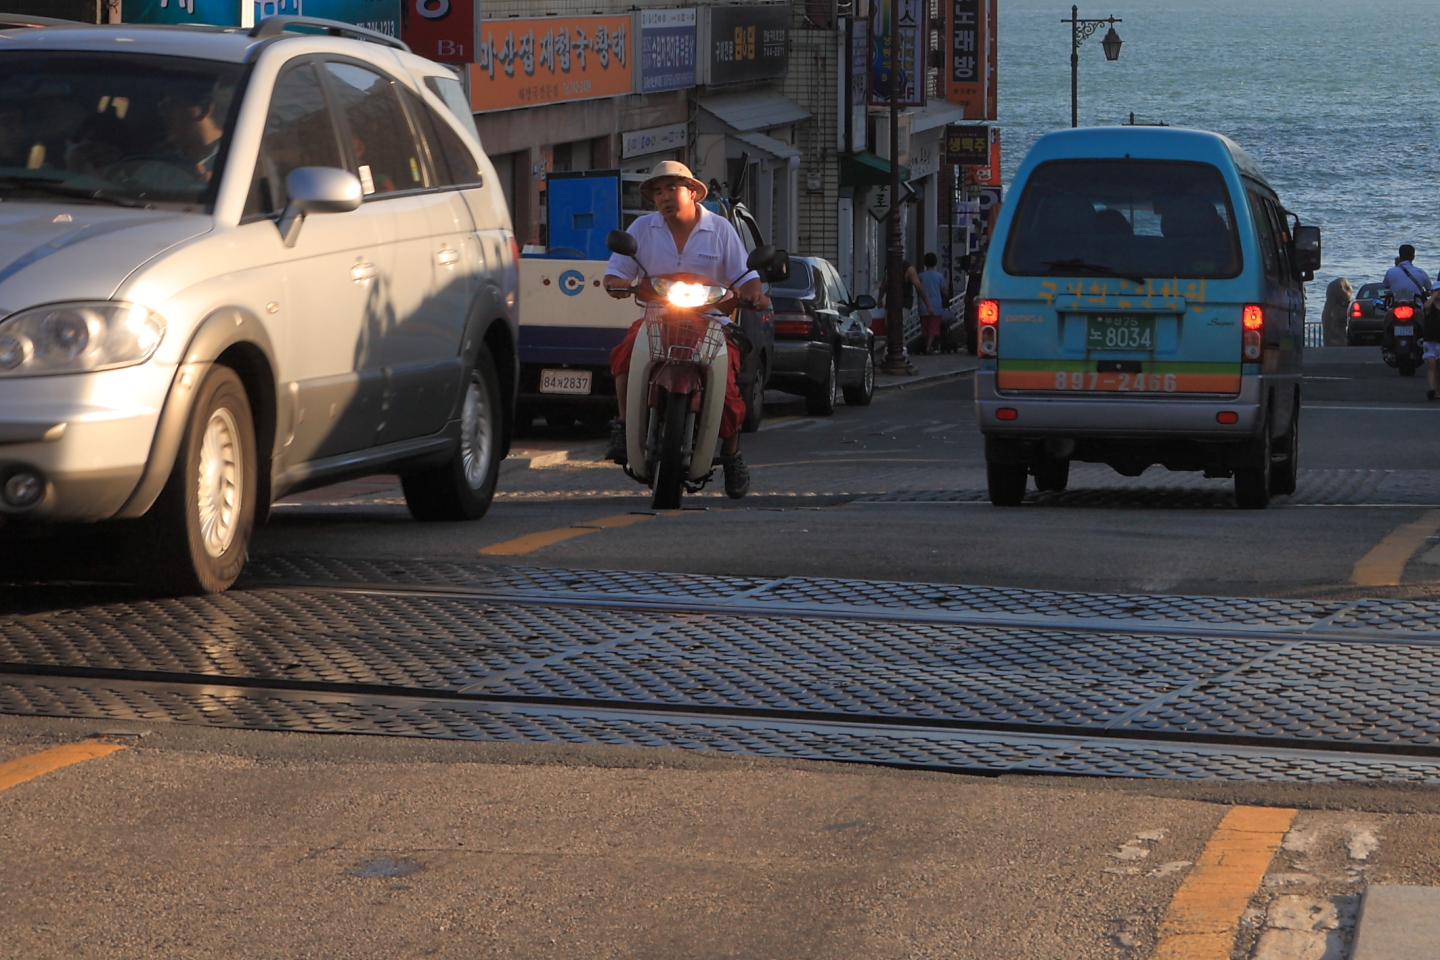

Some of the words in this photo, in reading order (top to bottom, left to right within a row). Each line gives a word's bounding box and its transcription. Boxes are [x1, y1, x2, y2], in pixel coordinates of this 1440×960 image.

[437, 40, 465, 56] B1
[954, 4, 975, 78] 노래방
[481, 29, 534, 80] 마산집
[948, 137, 986, 152] 생맥주
[1106, 327, 1151, 347] 8034
[1054, 371, 1177, 392] 897-2466
